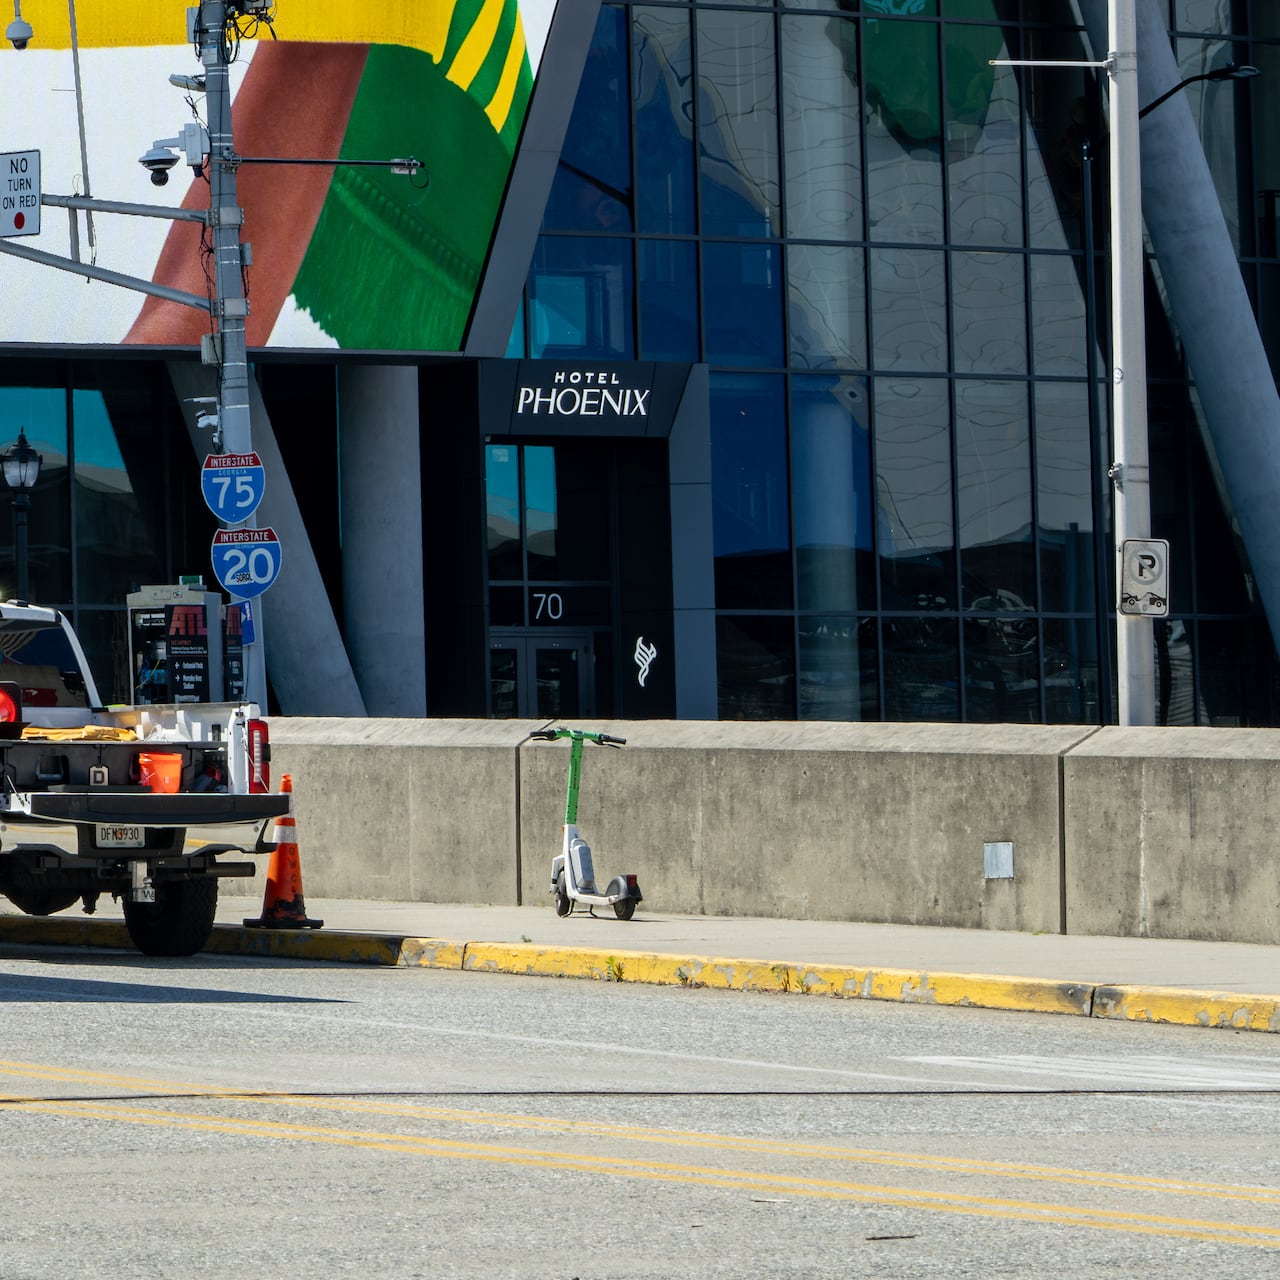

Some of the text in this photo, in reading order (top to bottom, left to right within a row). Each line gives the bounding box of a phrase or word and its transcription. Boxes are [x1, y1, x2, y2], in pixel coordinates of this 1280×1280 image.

[10, 158, 28, 174] NO
[8, 178, 32, 191] TURN
[3, 195, 37, 209] ON RED
[554, 372, 619, 384] HOTEL
[517, 387, 650, 415] PHOENIX
[211, 455, 254, 467] INTERSTATE
[212, 476, 255, 509] 75
[220, 532, 269, 542] INTERSTATE
[223, 548, 274, 586] 20
[533, 593, 563, 619] 70
[169, 606, 208, 635] ATL
[93, 770, 105, 785] D
